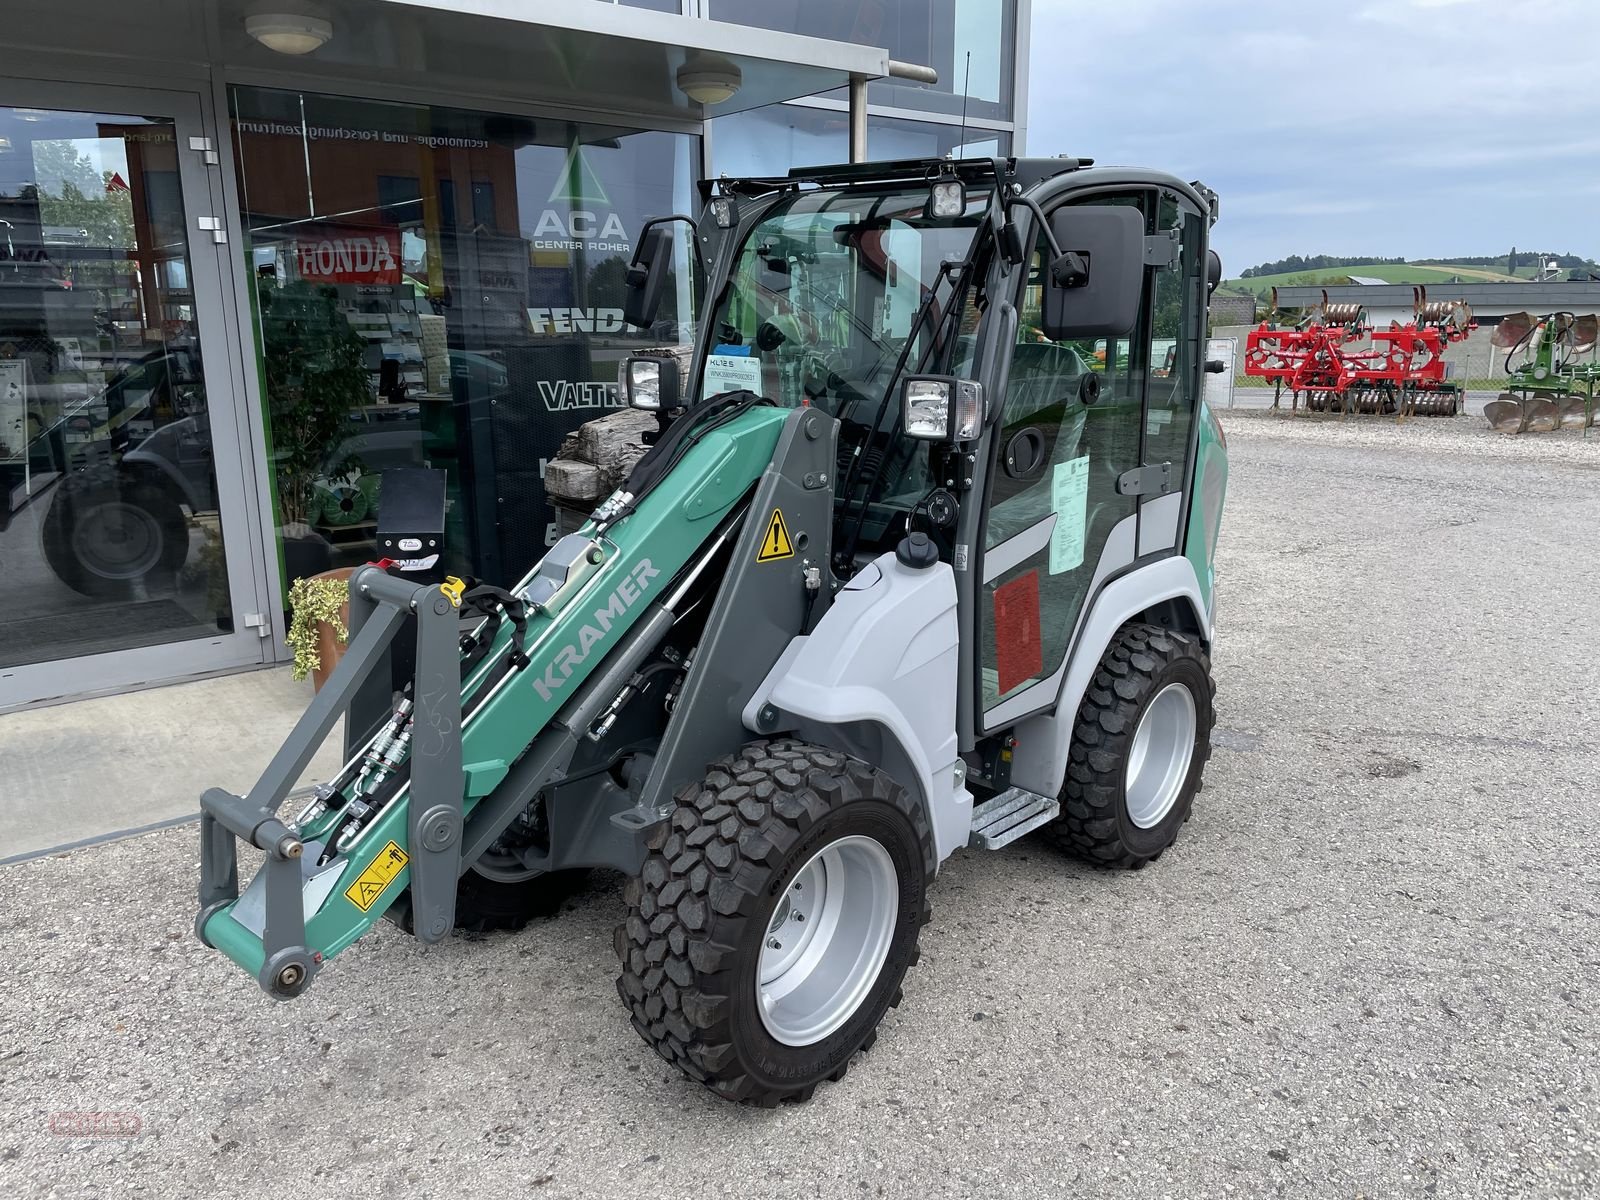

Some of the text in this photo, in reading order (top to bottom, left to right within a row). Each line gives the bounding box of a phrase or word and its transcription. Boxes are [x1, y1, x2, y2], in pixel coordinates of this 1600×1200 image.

[533, 209, 629, 240] ACA
[300, 235, 397, 275] HONDA
[534, 240, 630, 252] CENTER ROHER
[527, 307, 637, 333] FEND
[537, 380, 628, 411] VALTR
[532, 558, 661, 702] KRAMER
